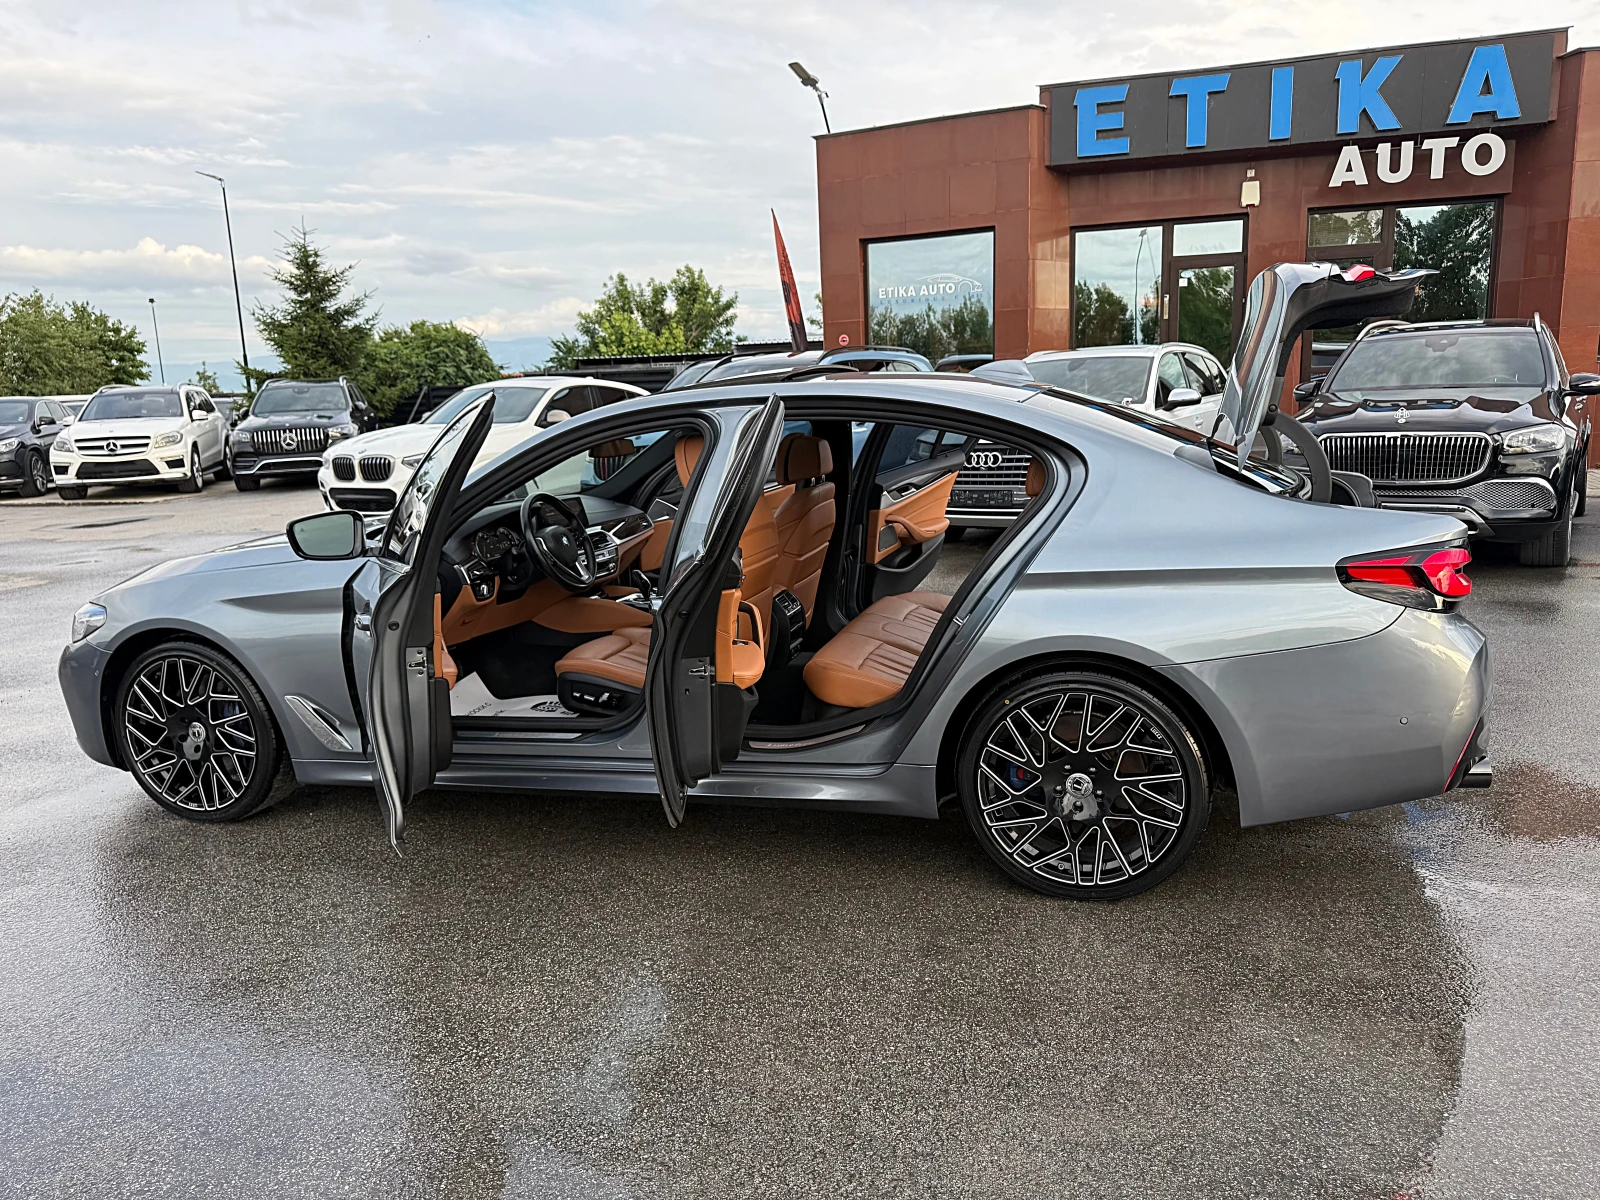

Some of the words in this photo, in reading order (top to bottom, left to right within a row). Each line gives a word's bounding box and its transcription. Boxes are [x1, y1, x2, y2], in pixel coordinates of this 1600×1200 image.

[1073, 44, 1522, 158] ETIKA
[1328, 133, 1506, 187] AUTO
[878, 285, 916, 299] ETIKA
[920, 283, 956, 296] AUTO
